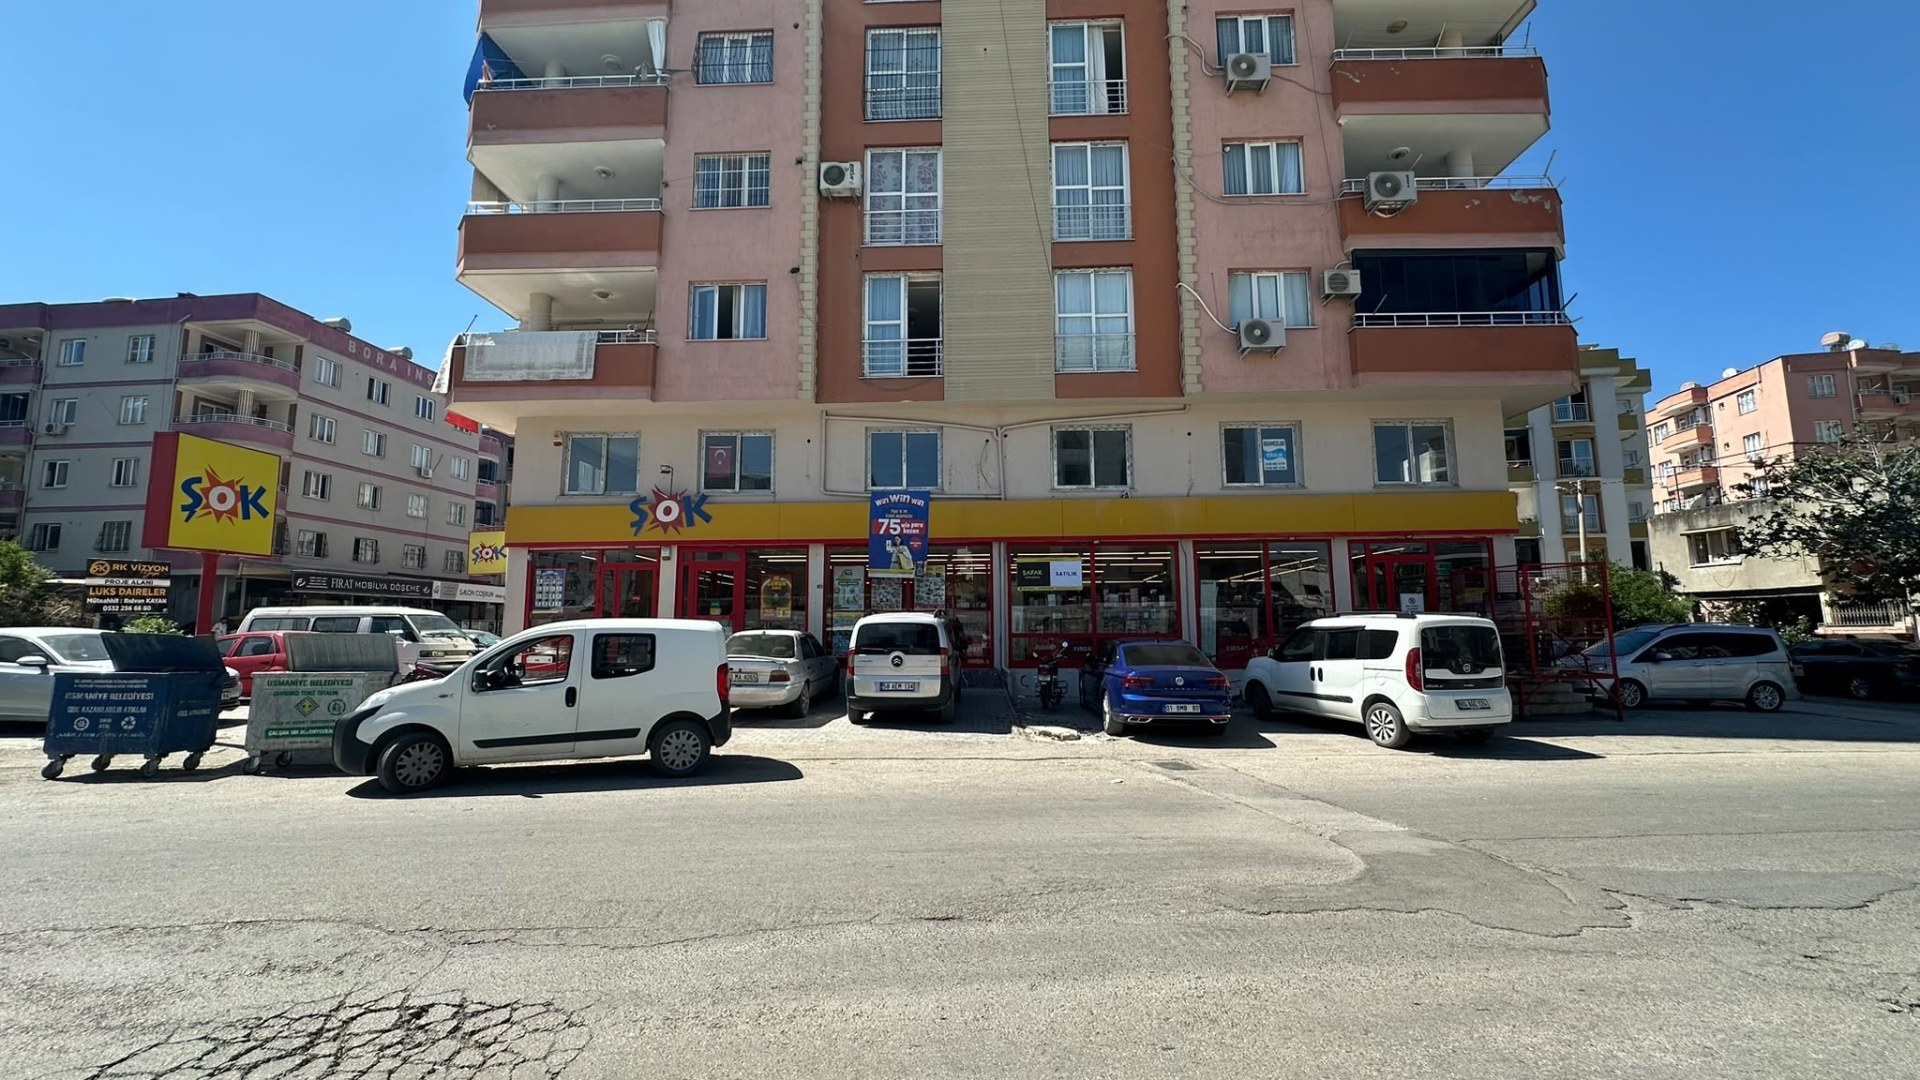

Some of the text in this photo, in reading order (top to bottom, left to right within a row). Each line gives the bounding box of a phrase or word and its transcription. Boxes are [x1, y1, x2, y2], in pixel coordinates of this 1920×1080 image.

[348, 340, 397, 371] BORA
[181, 476, 269, 523] ŞOK
[889, 494, 911, 503] win
[629, 493, 713, 537] ŞOK
[878, 518, 901, 535] 75
[472, 545, 507, 565] ŞOK
[112, 562, 169, 572] RK VİZYON
[331, 578, 353, 589] FIRAT
[354, 581, 388, 590] MOBİLYA
[267, 678, 353, 687] OSMANİYE BELEDİYESİ
